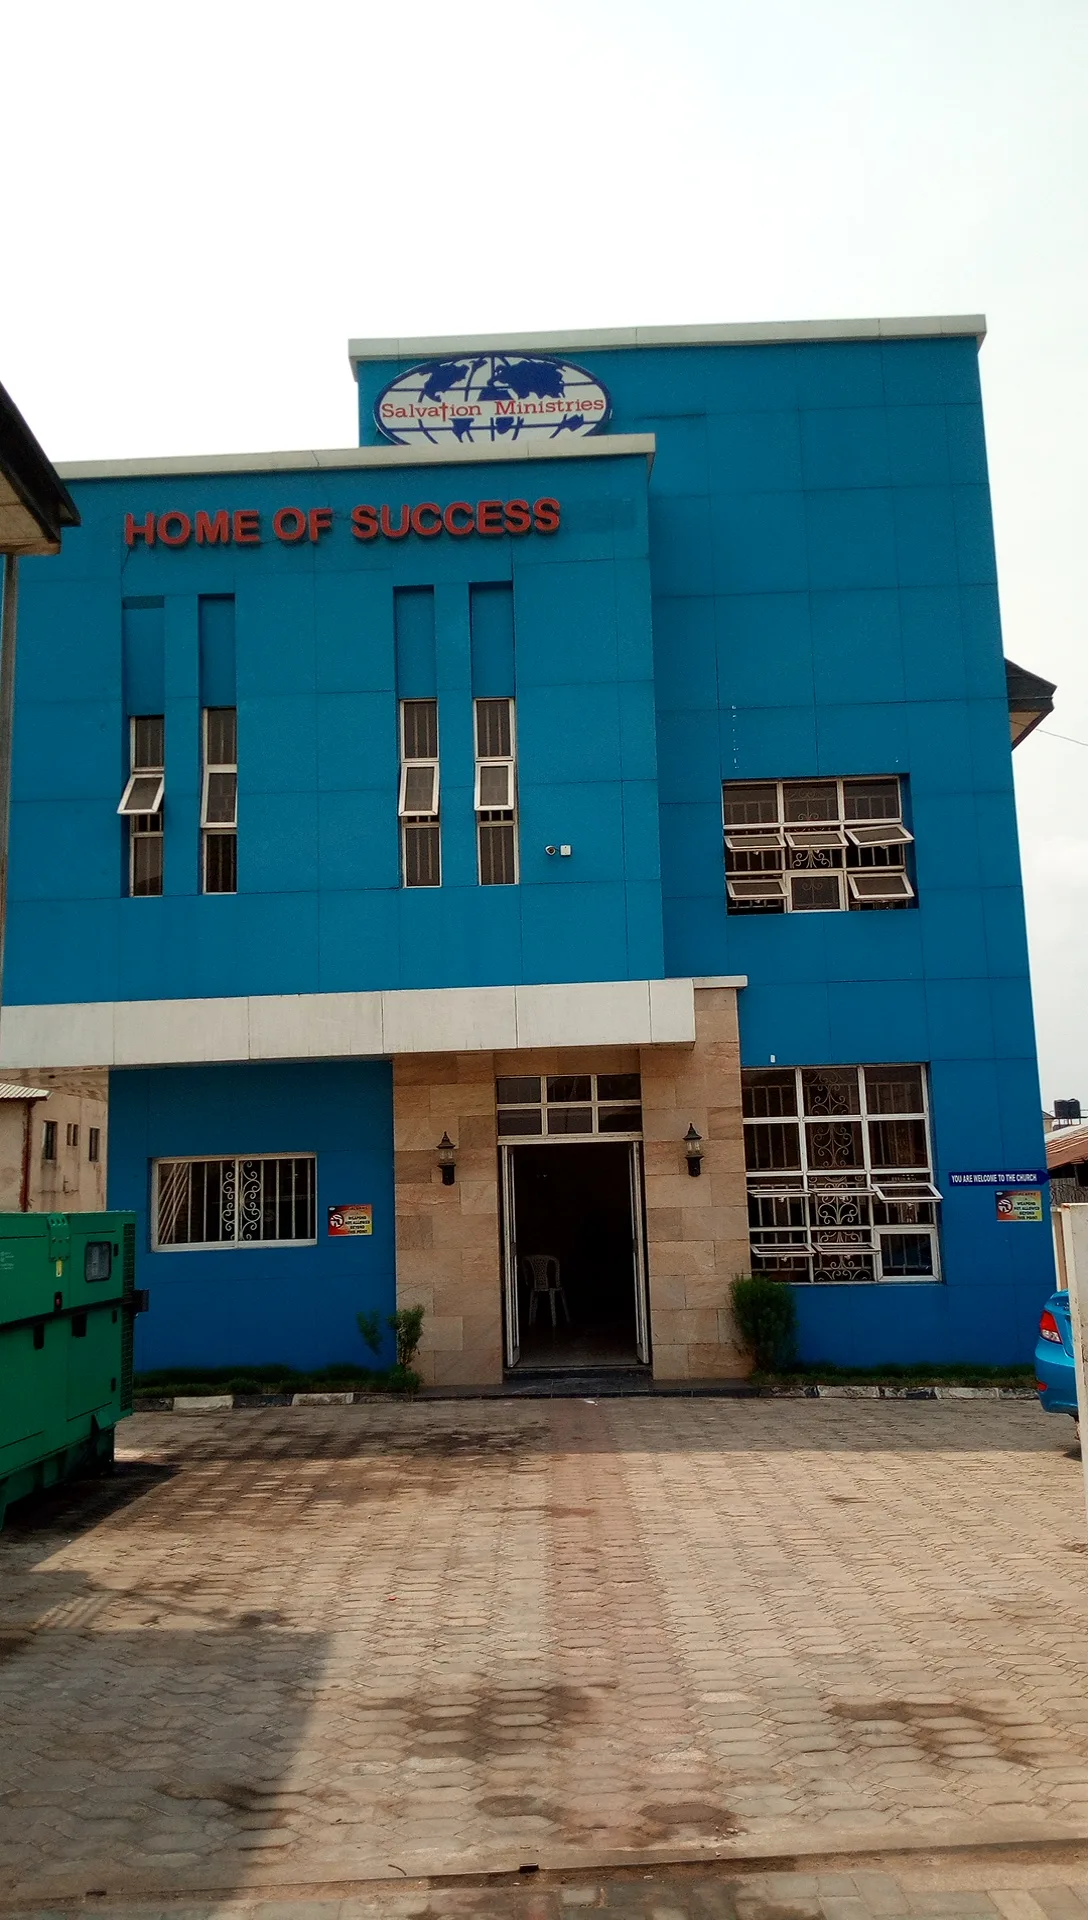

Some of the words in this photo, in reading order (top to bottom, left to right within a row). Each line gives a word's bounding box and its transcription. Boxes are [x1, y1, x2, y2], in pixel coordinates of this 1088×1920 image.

[381, 402, 482, 422] Salvation
[494, 399, 604, 416] Ministries
[124, 510, 260, 545] HOME
[273, 507, 332, 541] OF
[350, 497, 560, 538] SUCCESS
[951, 1175, 962, 1183] YOU
[963, 1175, 973, 1183] ARE
[973, 1174, 997, 1182] WELCOME
[998, 1174, 1005, 1182] TO
[1005, 1174, 1016, 1182] THE
[1016, 1174, 1037, 1182] CHURCH
